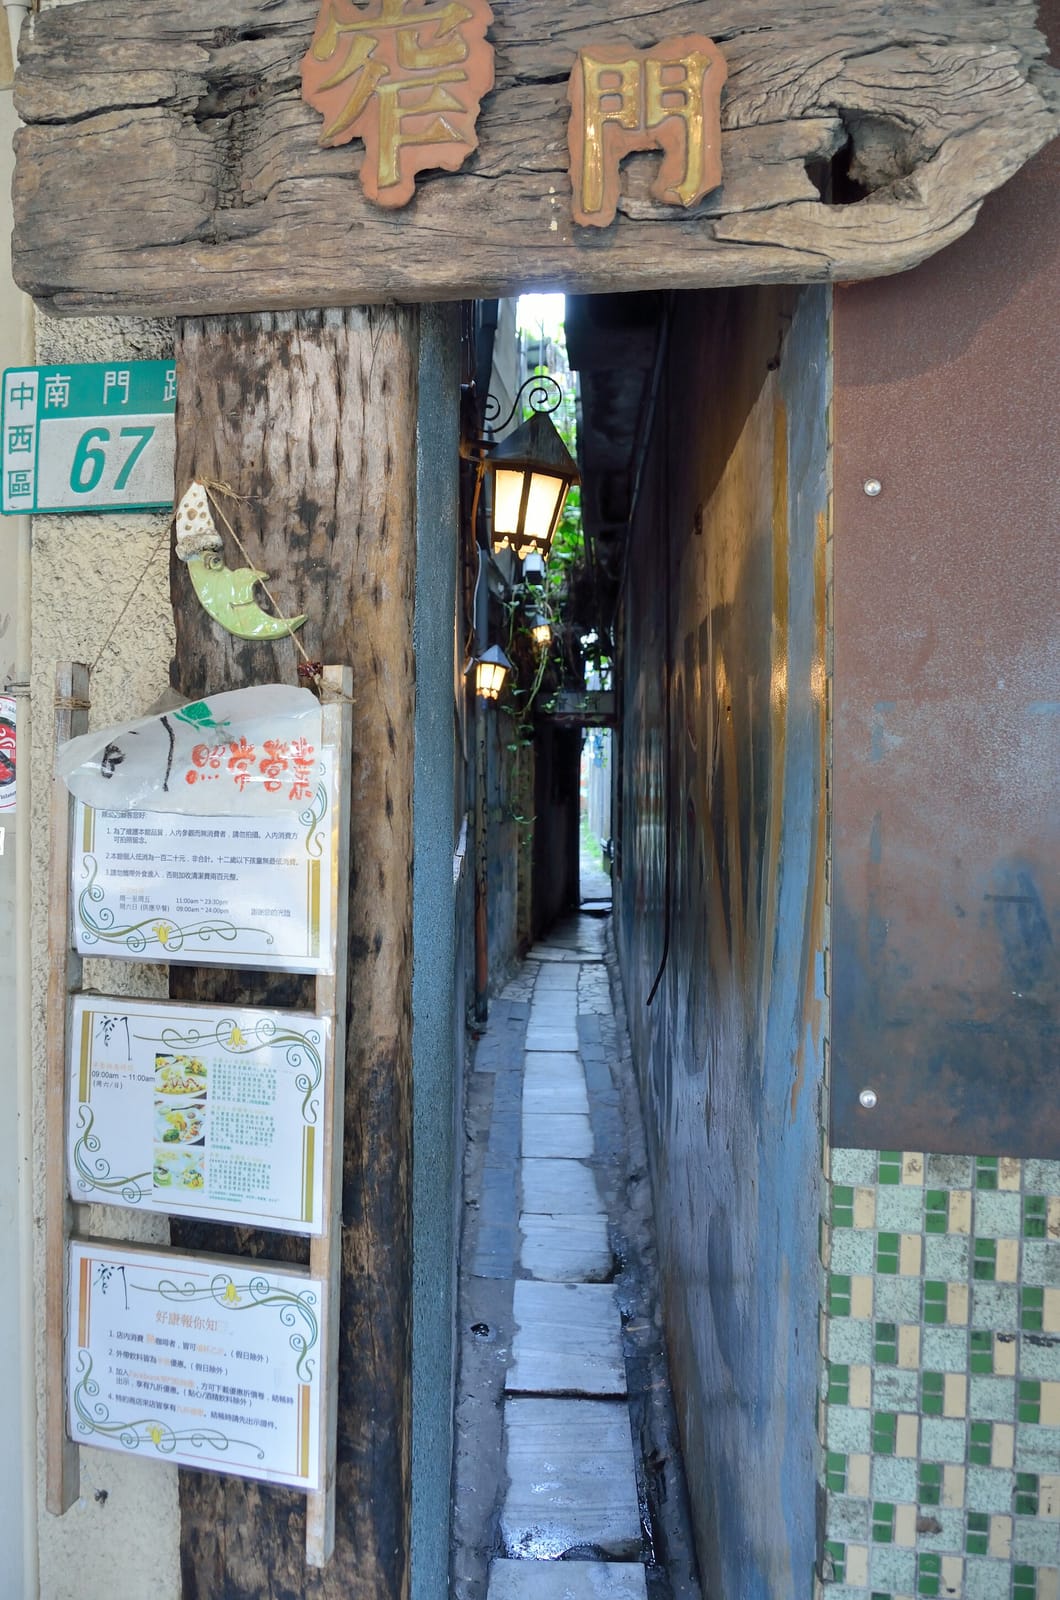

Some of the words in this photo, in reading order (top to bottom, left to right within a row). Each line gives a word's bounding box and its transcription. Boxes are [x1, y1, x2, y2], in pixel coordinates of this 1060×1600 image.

[9, 380, 35, 500] 中西區
[70, 424, 156, 495] 67
